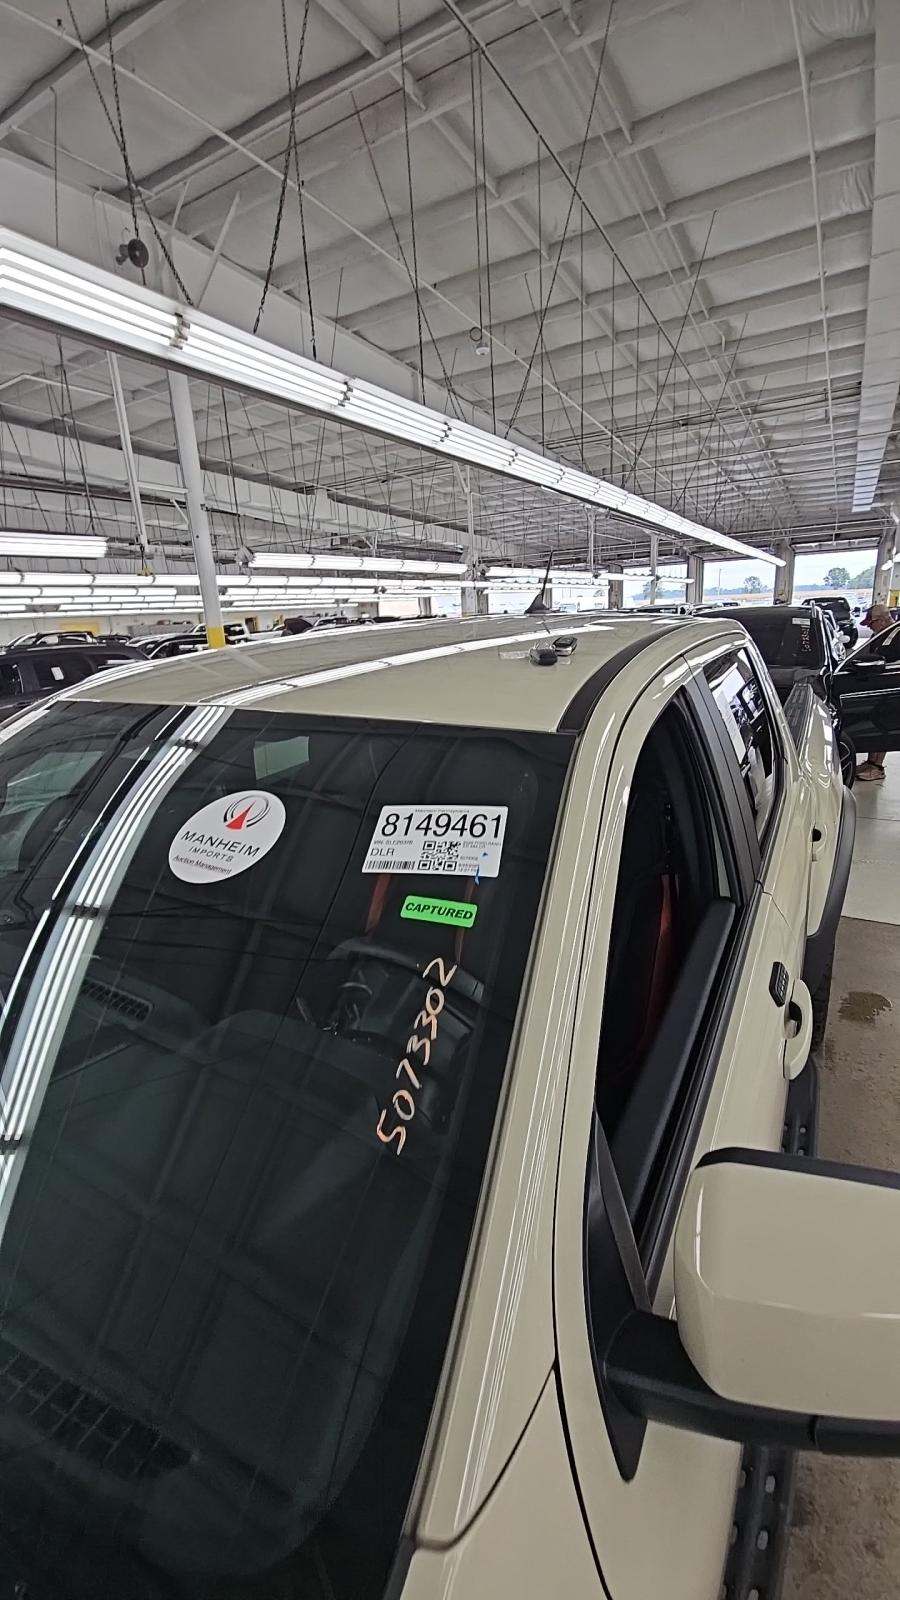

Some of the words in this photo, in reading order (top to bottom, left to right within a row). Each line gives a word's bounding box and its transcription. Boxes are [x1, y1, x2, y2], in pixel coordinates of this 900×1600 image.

[381, 813, 502, 838] 8149461
[180, 830, 260, 858] MANHEIM
[188, 846, 234, 862] IMPORTS
[370, 848, 396, 857] DLR
[172, 854, 195, 866] Auction
[195, 858, 232, 874] Management
[404, 902, 475, 920] CAPTURED
[376, 957, 458, 1156] 5073302
